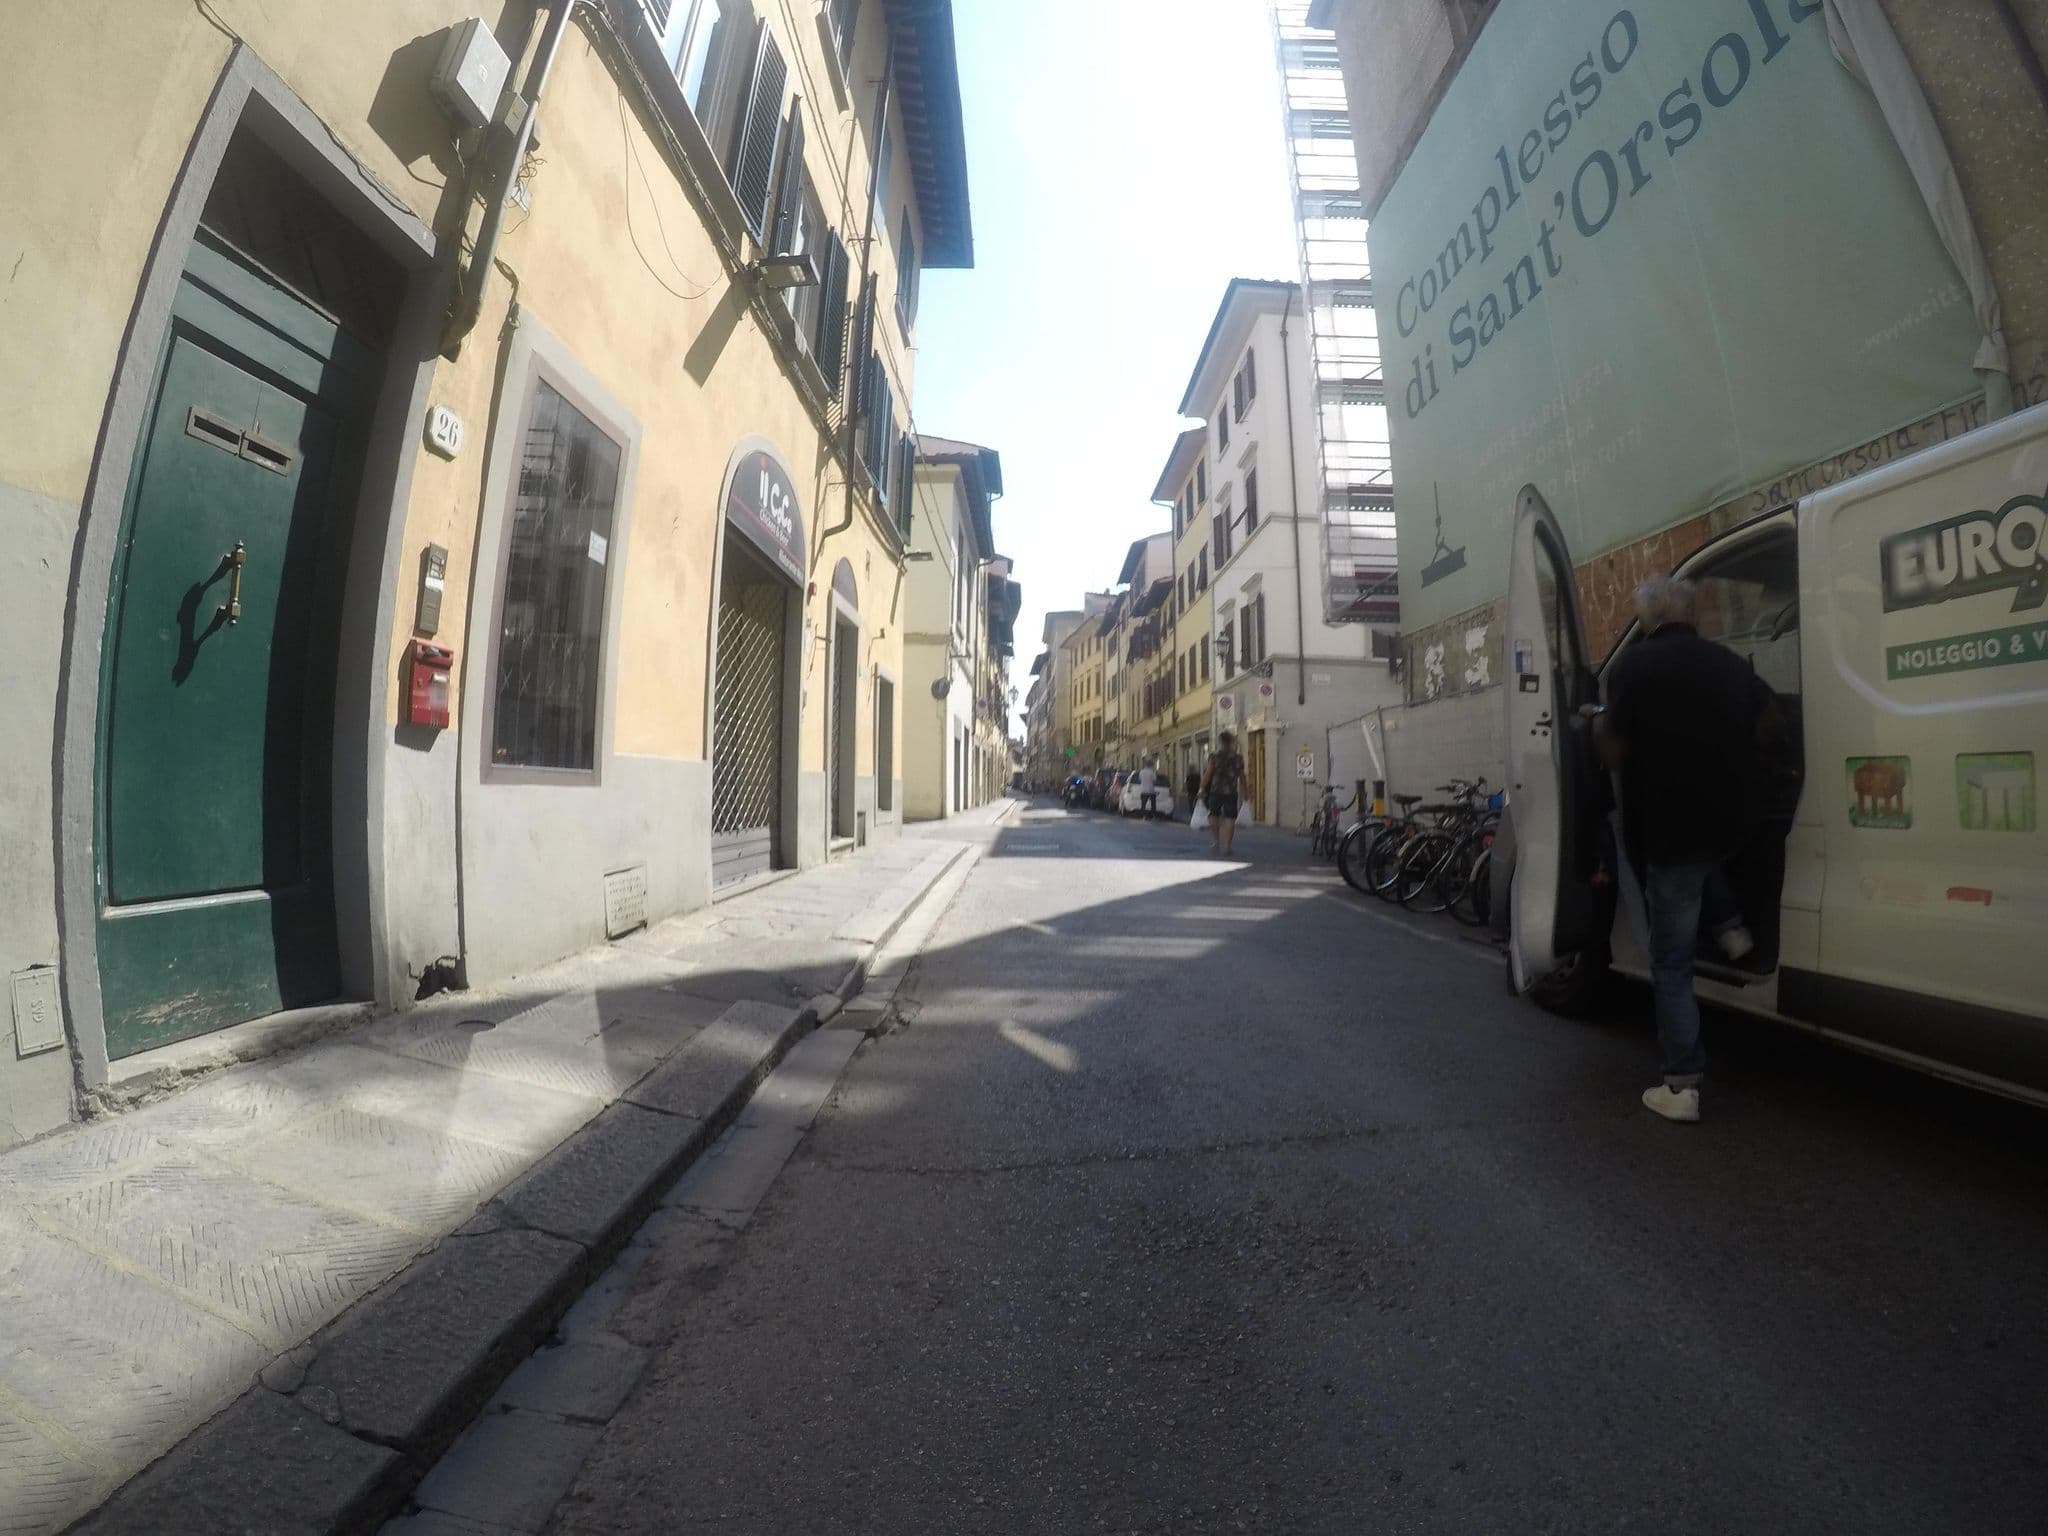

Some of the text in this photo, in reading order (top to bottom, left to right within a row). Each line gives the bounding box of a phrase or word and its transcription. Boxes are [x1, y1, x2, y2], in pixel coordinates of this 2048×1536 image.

[1395, 10, 1639, 338] Complesso
[1405, 342, 1439, 420] di
[437, 413, 459, 447] 26
[1896, 629, 2048, 672] NOLEGGIO & V
